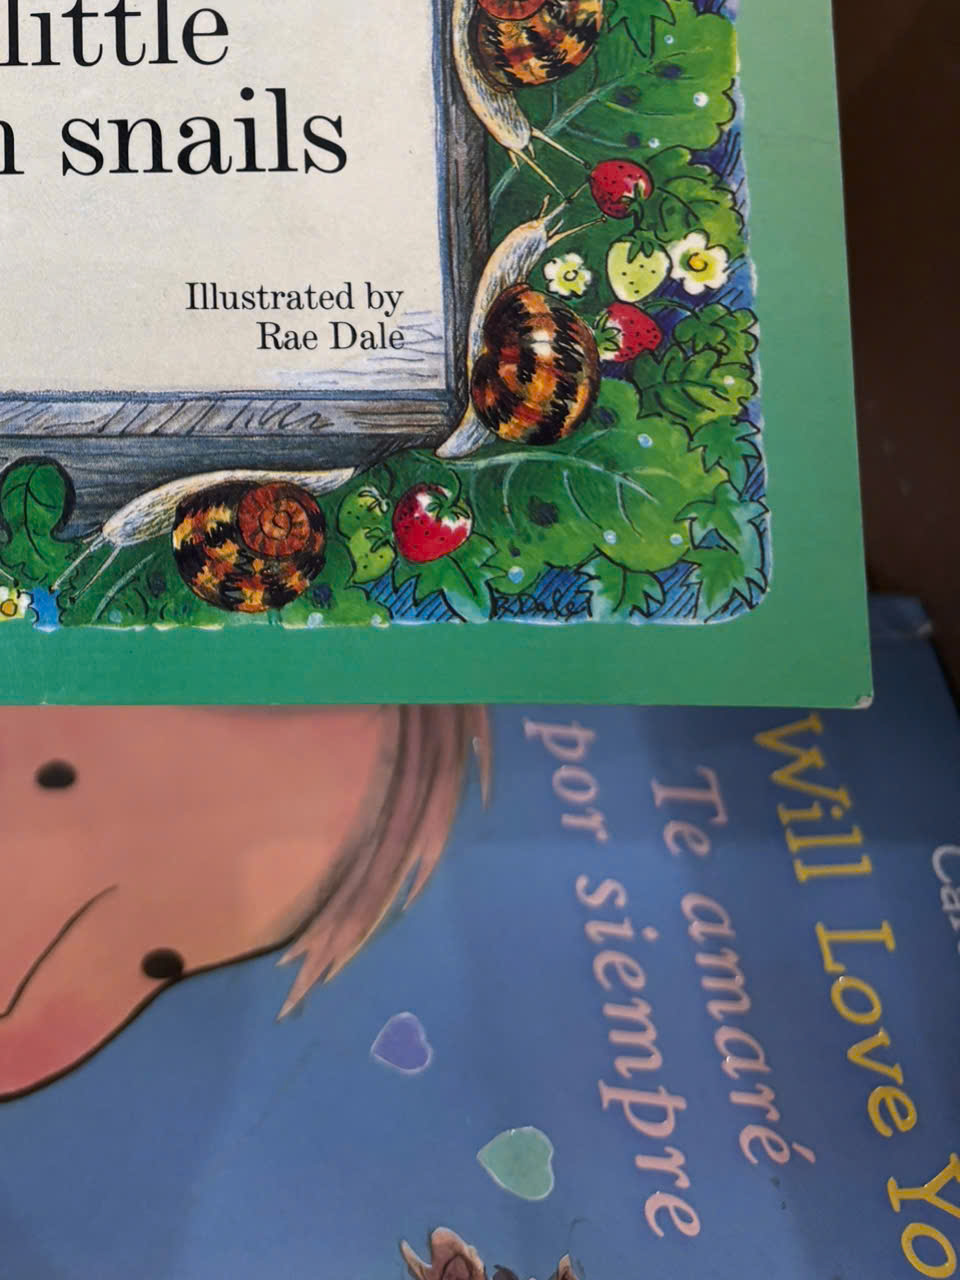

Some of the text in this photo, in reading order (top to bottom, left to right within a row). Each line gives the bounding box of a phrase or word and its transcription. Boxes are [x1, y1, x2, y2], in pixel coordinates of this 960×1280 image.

[60, 85, 349, 178] snails
[184, 279, 404, 317] Illustrated by
[255, 319, 406, 353] Rae Dale
[522, 716, 702, 1240] por siempre
[650, 765, 817, 1167] Te amaré
[753, 712, 872, 882] Will
[813, 920, 918, 1138] Love
